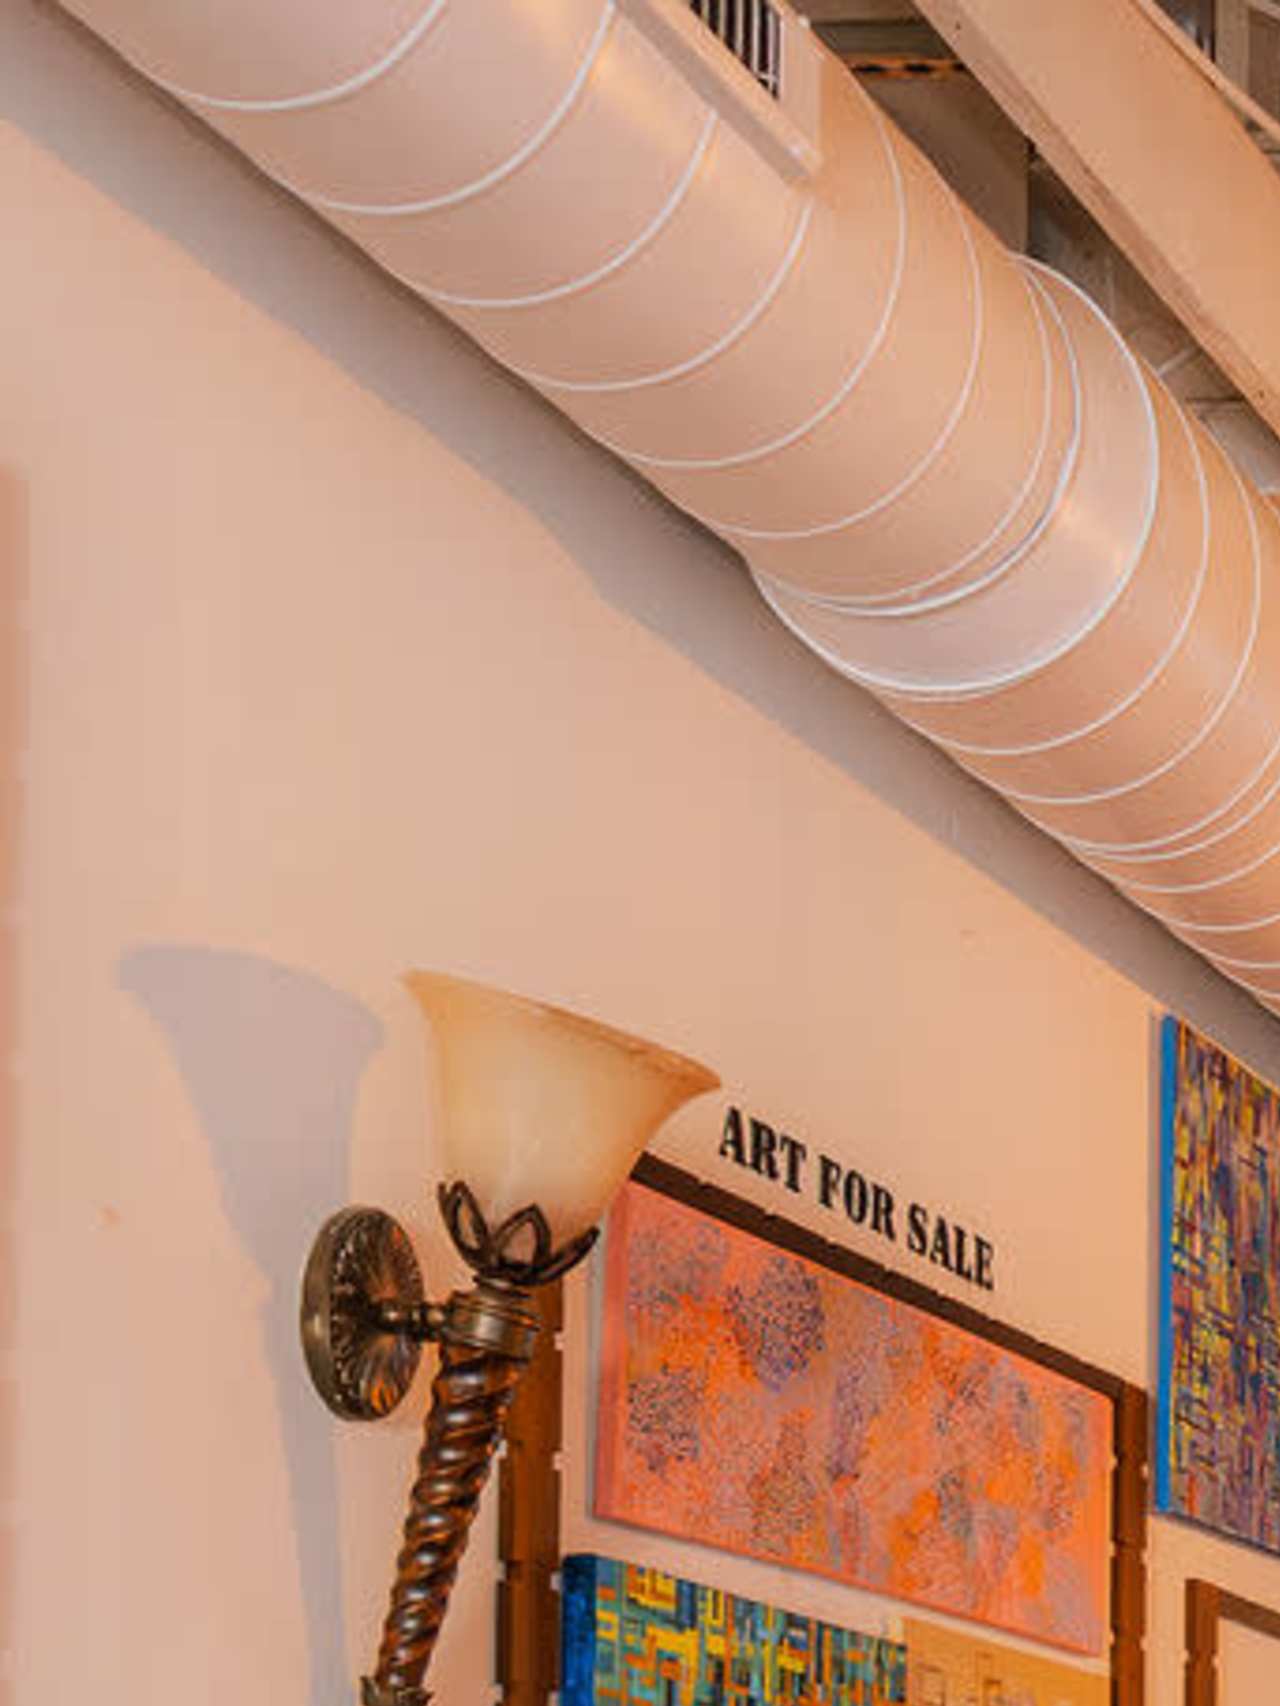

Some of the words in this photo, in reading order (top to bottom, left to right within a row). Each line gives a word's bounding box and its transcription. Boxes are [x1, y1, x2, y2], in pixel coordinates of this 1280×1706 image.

[719, 1106, 806, 1194] ART
[818, 1154, 896, 1242] FOR
[907, 1202, 994, 1291] SALE
